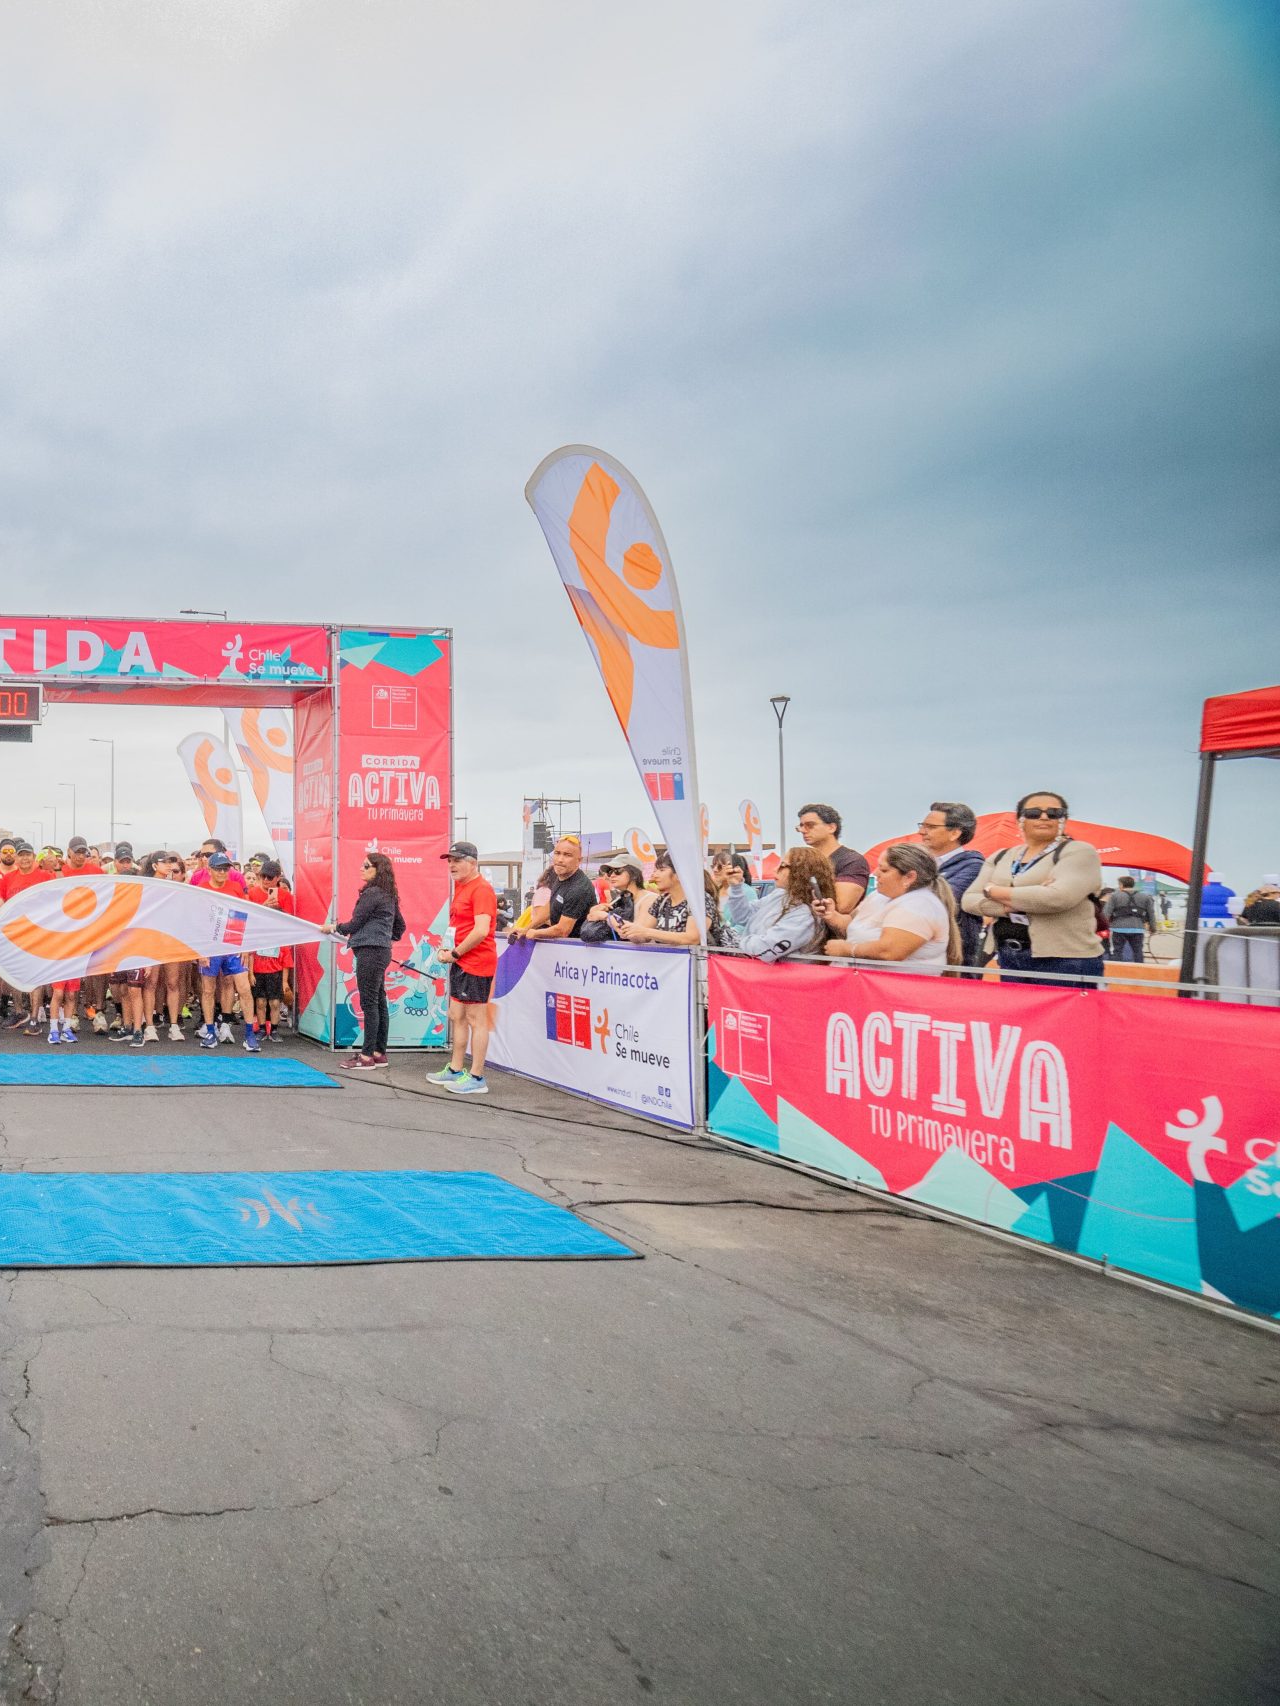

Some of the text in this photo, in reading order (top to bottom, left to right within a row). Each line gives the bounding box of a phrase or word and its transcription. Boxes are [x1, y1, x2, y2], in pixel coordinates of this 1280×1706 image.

[248, 649, 281, 661] Chile
[248, 662, 315, 675] Se mueve
[365, 757, 417, 767] CORRIDA
[348, 770, 441, 810] ACTIVA
[367, 808, 378, 820] TU
[381, 847, 402, 855] Chile
[554, 961, 659, 991] Arica y Parinacota
[615, 1023, 639, 1042] Chile
[616, 1042, 670, 1069] Se mueve
[826, 1011, 1073, 1150] ACTIVA
[868, 1103, 892, 1139] TU
